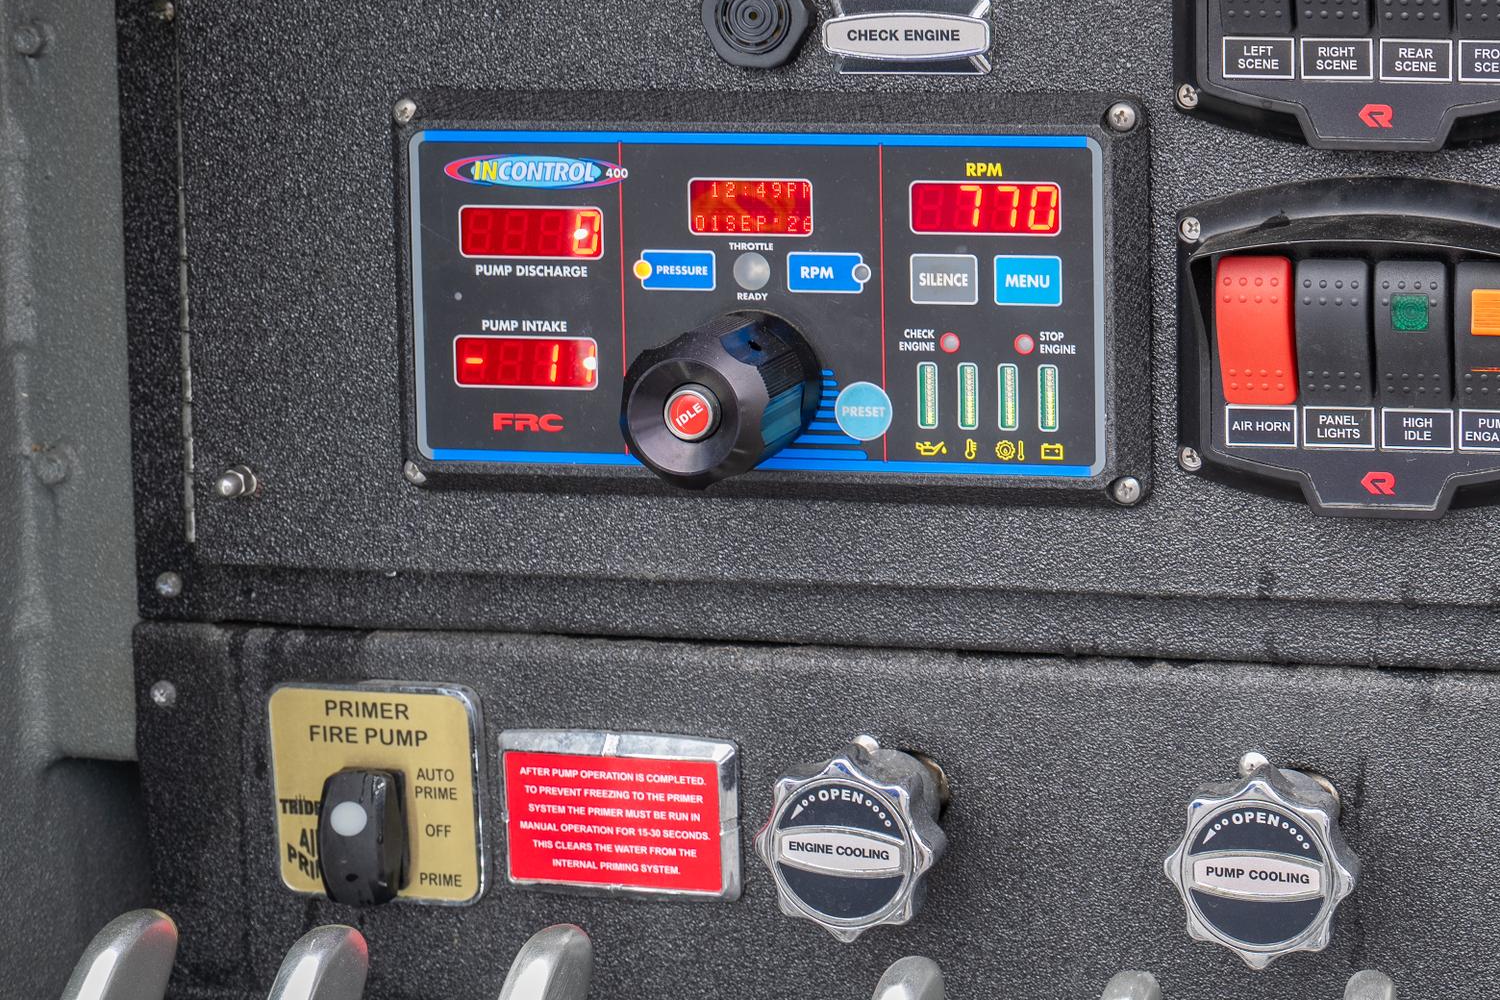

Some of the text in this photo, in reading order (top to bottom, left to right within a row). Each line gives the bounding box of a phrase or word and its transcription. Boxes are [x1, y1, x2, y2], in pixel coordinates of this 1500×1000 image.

[847, 29, 960, 41] CHECK ENGINE
[1244, 46, 1273, 56] LEFT
[1318, 46, 1355, 58] RIGHT
[1399, 48, 1433, 59] REAR
[1238, 58, 1279, 70] SCENE
[1316, 59, 1358, 71] SCENE
[1395, 60, 1437, 72] SCENE
[473, 160, 628, 183] INCONTROL 400
[966, 163, 1003, 177] RPM
[960, 186, 1057, 230] 770
[729, 242, 774, 251] THROTTLE
[475, 265, 588, 278] PUMP DISCHARGE
[656, 265, 708, 276] PRESSURE
[800, 267, 834, 279] RPM
[919, 273, 968, 287] SILENCE
[1005, 275, 1050, 288] MENU
[737, 292, 768, 301] READY
[482, 320, 567, 332] PUMP INTAKE
[904, 329, 935, 339] CHECK
[899, 341, 935, 352] ENGINE
[1040, 344, 1076, 355] ENGINE
[675, 402, 704, 428] IDLE
[841, 406, 885, 417] PRESET
[493, 412, 564, 433] FRC
[1232, 421, 1291, 432] AIR HORN
[1319, 415, 1359, 426] PANEL
[1403, 417, 1433, 428] HIGH
[1317, 427, 1360, 439] LIGHTS
[1404, 430, 1432, 441] IDLE
[325, 700, 409, 720] PRIMER
[309, 725, 428, 747] FIRE PUMP
[417, 768, 454, 781] AUTO
[520, 767, 550, 776] AFTER
[552, 770, 578, 778] PUMP
[580, 771, 634, 781] OPERATION
[415, 786, 457, 800] PRIME
[525, 785, 703, 803] TO PREVENT FREEZING TO THE PRIMER
[818, 789, 863, 804] OPEN
[1232, 812, 1280, 826] OPEN
[425, 824, 451, 837] OFF
[789, 841, 889, 860] ENGINE COOLING
[420, 873, 462, 887] PRIME
[1206, 866, 1309, 884] PUMP COOLING
